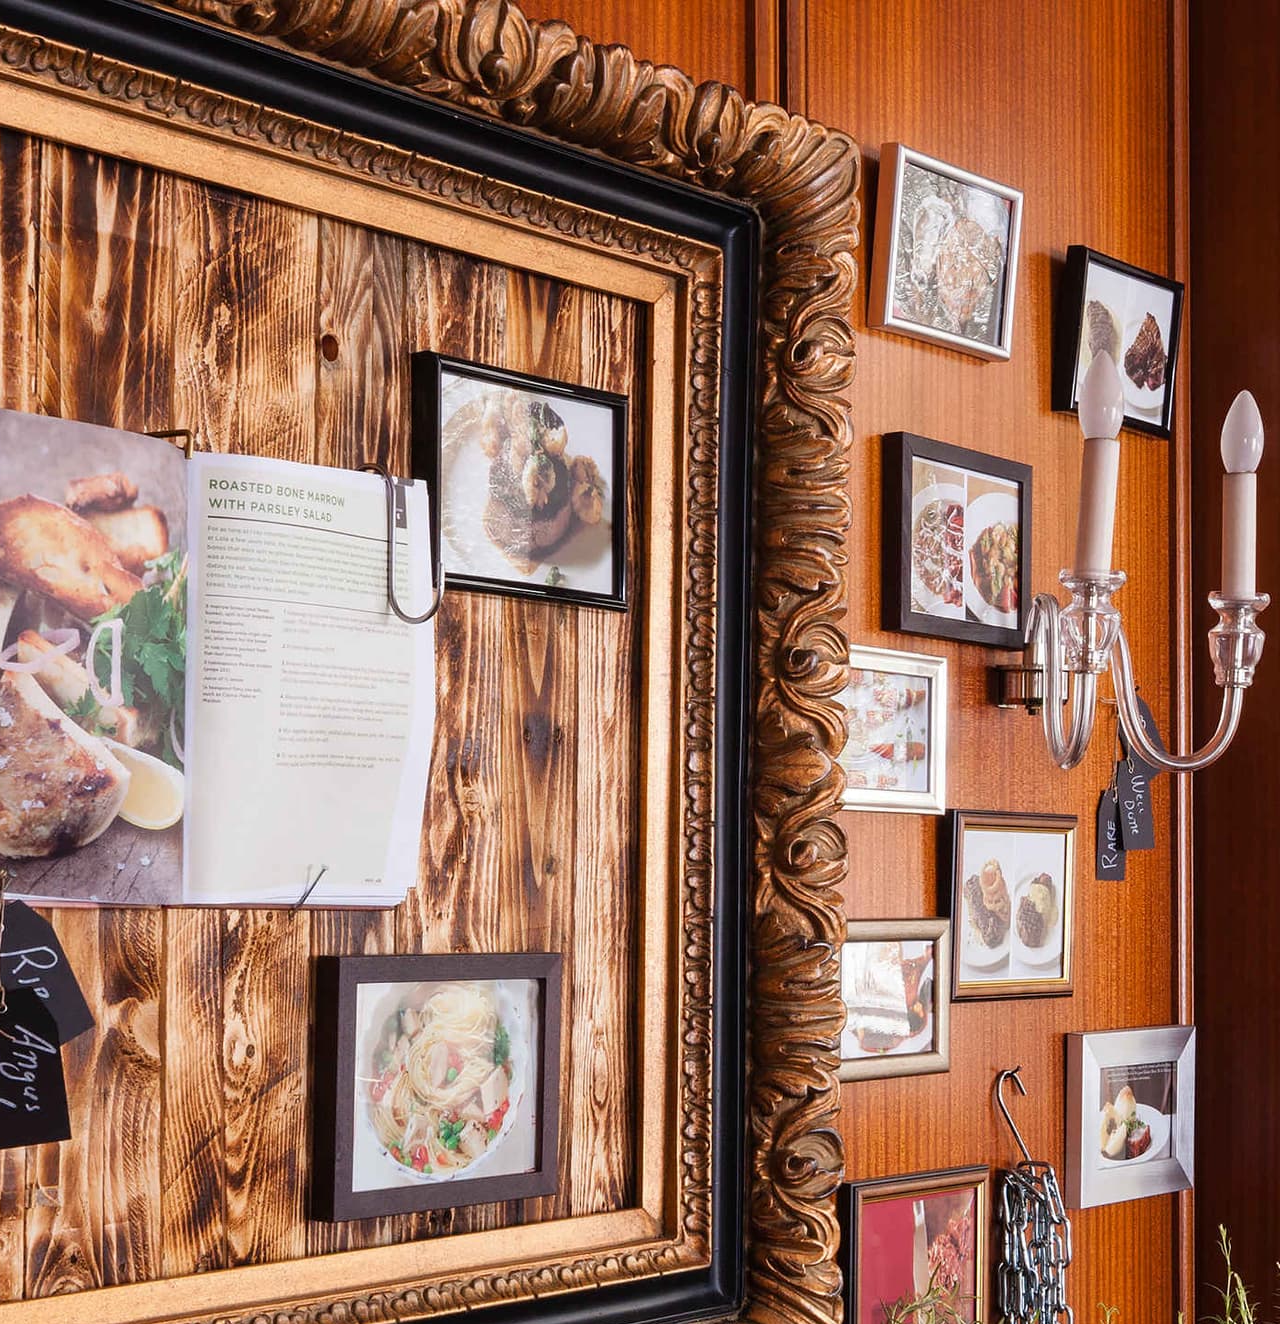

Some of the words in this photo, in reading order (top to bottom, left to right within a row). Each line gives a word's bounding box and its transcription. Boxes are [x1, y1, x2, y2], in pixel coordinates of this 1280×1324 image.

[209, 479, 273, 494] ROASTED
[276, 486, 304, 500] BONE
[308, 491, 345, 507] MARROW
[209, 498, 246, 511] WITH
[251, 502, 301, 517] PARSLEY
[303, 510, 332, 522] SALAD
